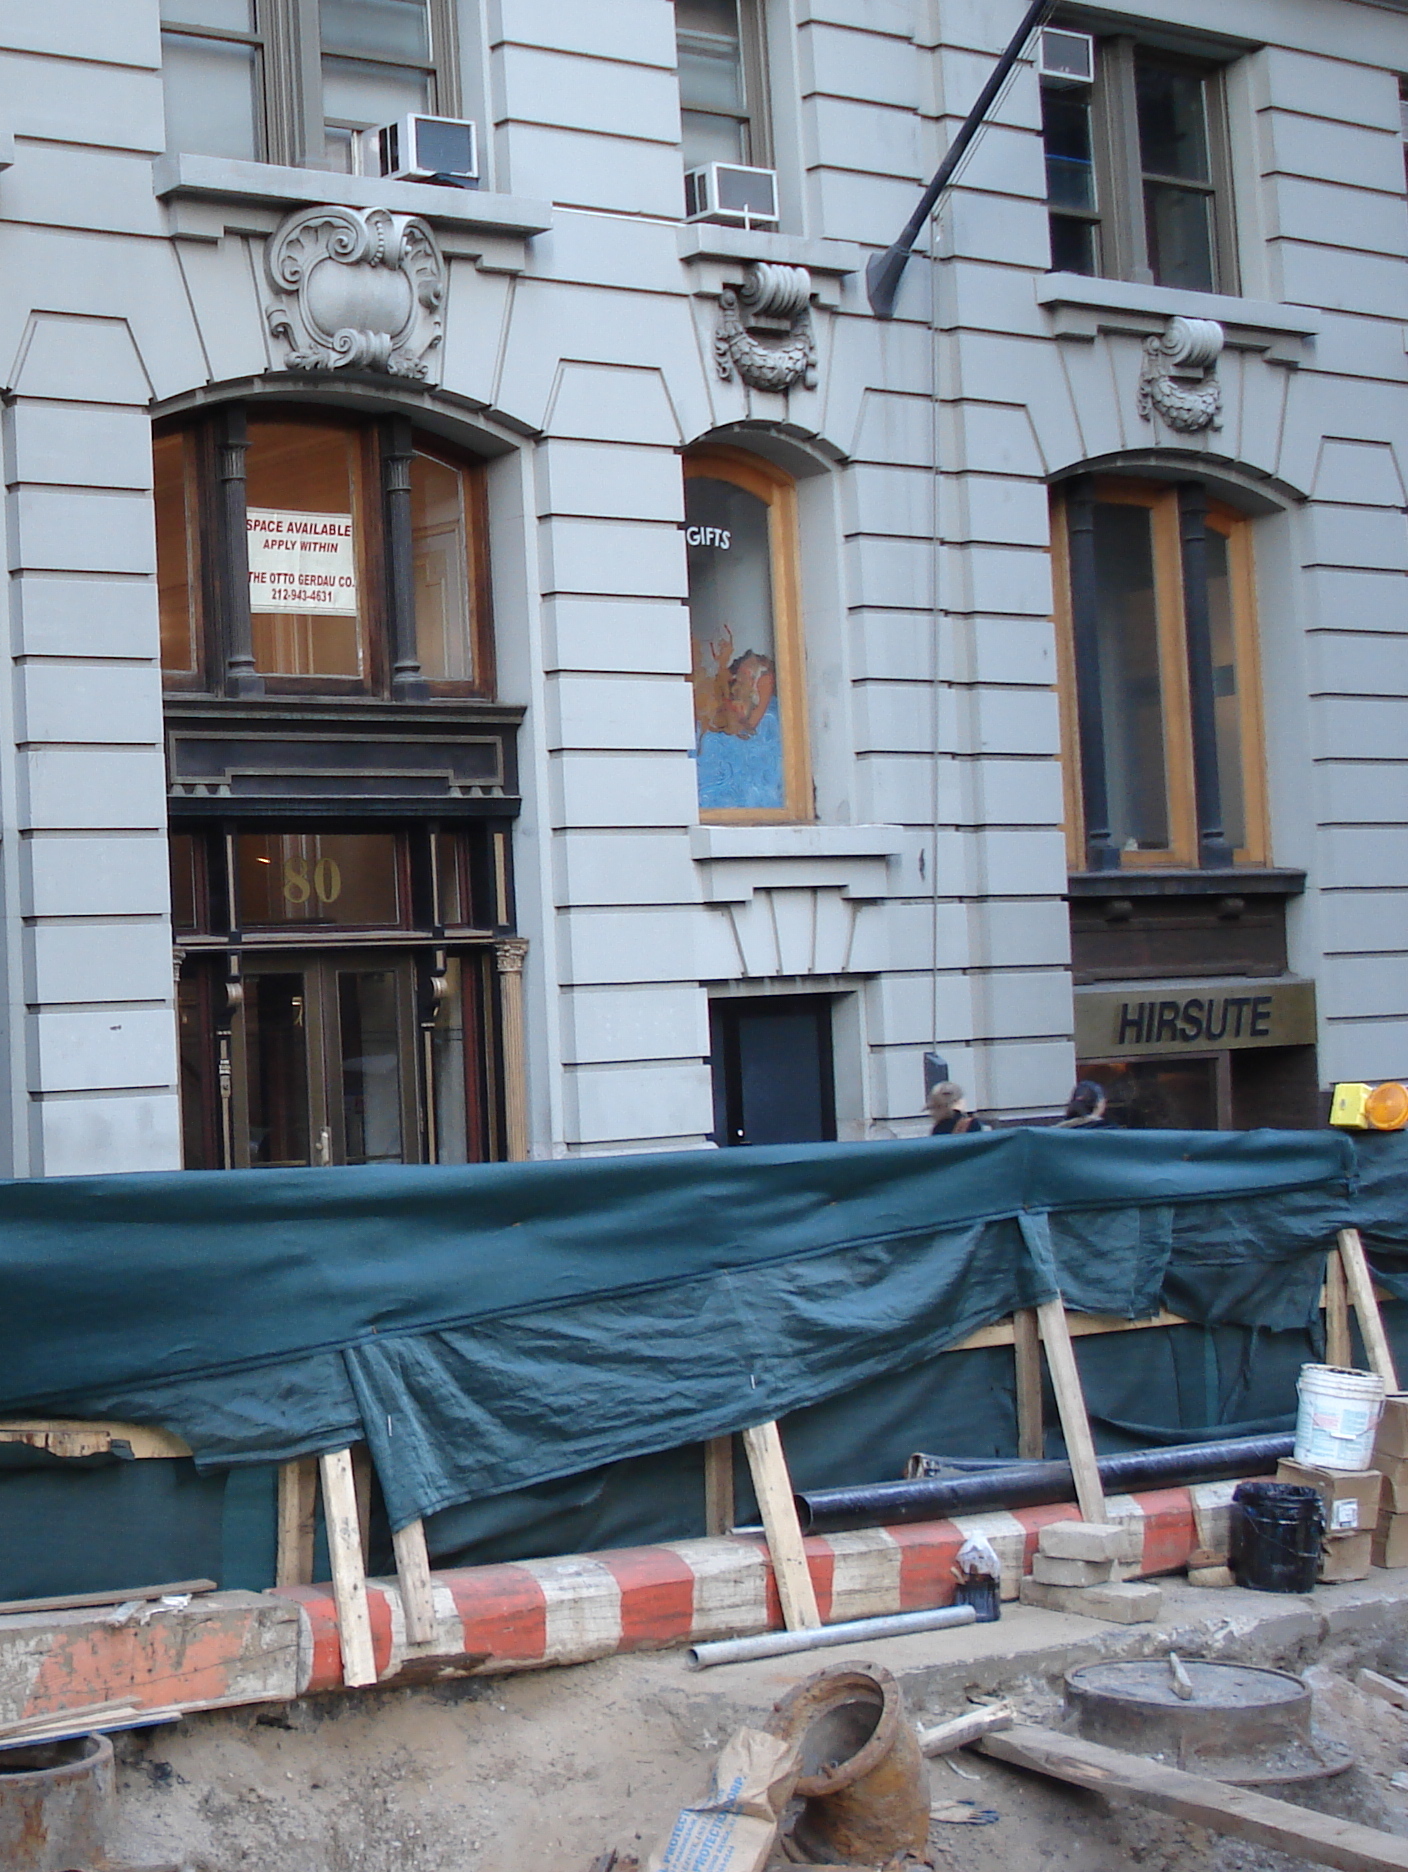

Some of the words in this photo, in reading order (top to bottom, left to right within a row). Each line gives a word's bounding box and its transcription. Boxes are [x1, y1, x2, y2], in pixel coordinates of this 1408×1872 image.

[246, 519, 284, 533] SPACE
[286, 522, 352, 537] AVAILABLE
[263, 539, 297, 551] APPLY
[300, 540, 339, 553] WITHIN
[686, 526, 732, 550] GIFTS
[248, 571, 267, 583] THE
[269, 573, 295, 584] OTTO
[298, 574, 336, 587] GERDAU
[338, 576, 355, 587] CO.
[271, 588, 332, 602] 212-943-4631
[284, 856, 341, 903] 80
[1119, 996, 1273, 1044] HIRSUTE
